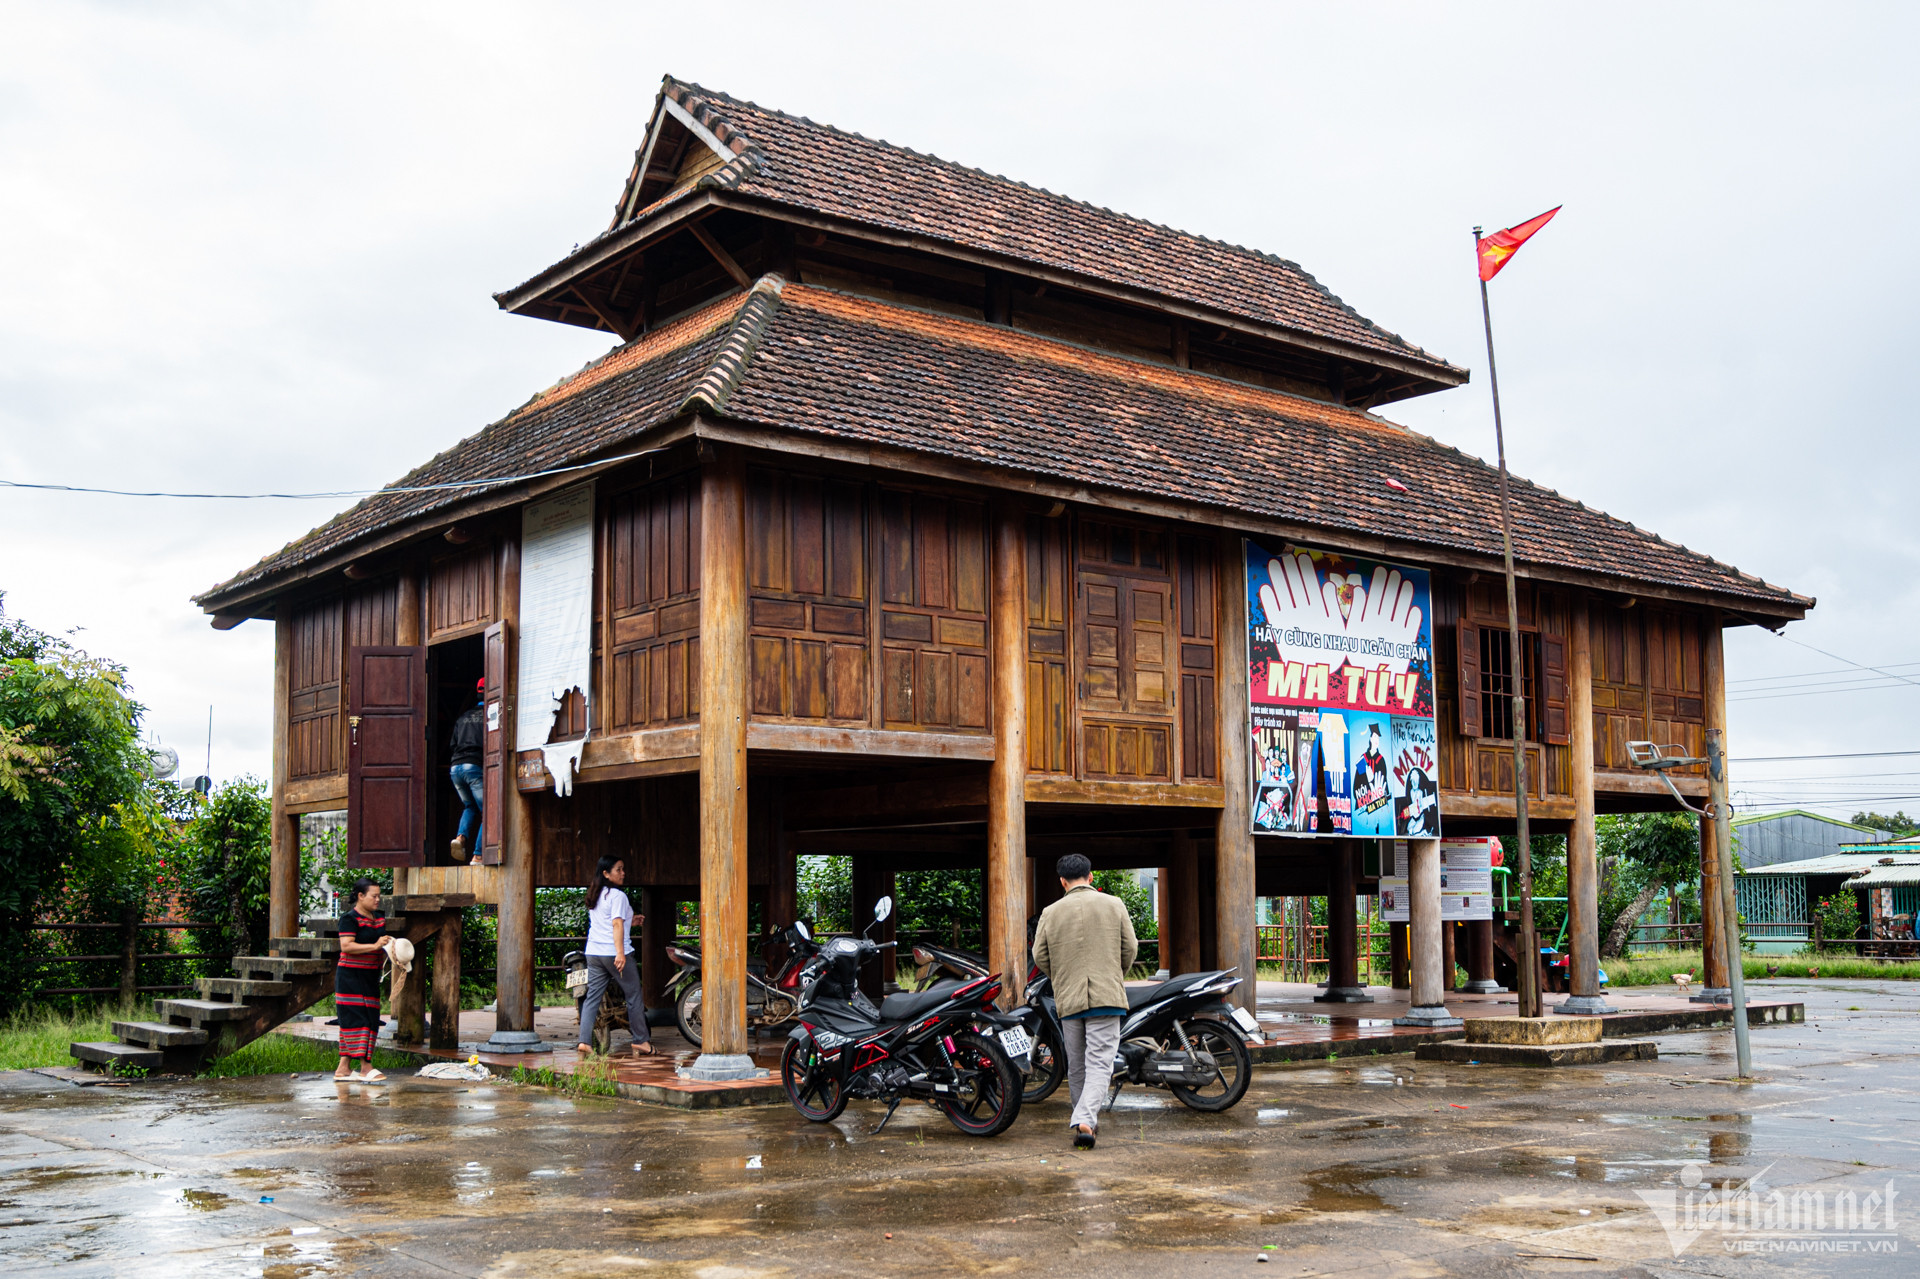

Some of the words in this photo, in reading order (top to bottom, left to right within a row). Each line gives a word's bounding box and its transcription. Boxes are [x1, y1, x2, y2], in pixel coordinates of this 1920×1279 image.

[1255, 624, 1283, 644] HÃY
[1285, 627, 1321, 648] CÙNG
[1324, 634, 1359, 653] NHAU
[1361, 637, 1394, 657] NGĂN
[1396, 642, 1427, 663] CHẶN
[1267, 660, 1330, 702] MA
[1342, 664, 1419, 709] TÚY
[1393, 748, 1416, 787] MA
[1413, 745, 1434, 773] TÚY
[1367, 802, 1377, 814] MA
[1003, 1028, 1023, 1043] 82-E1
